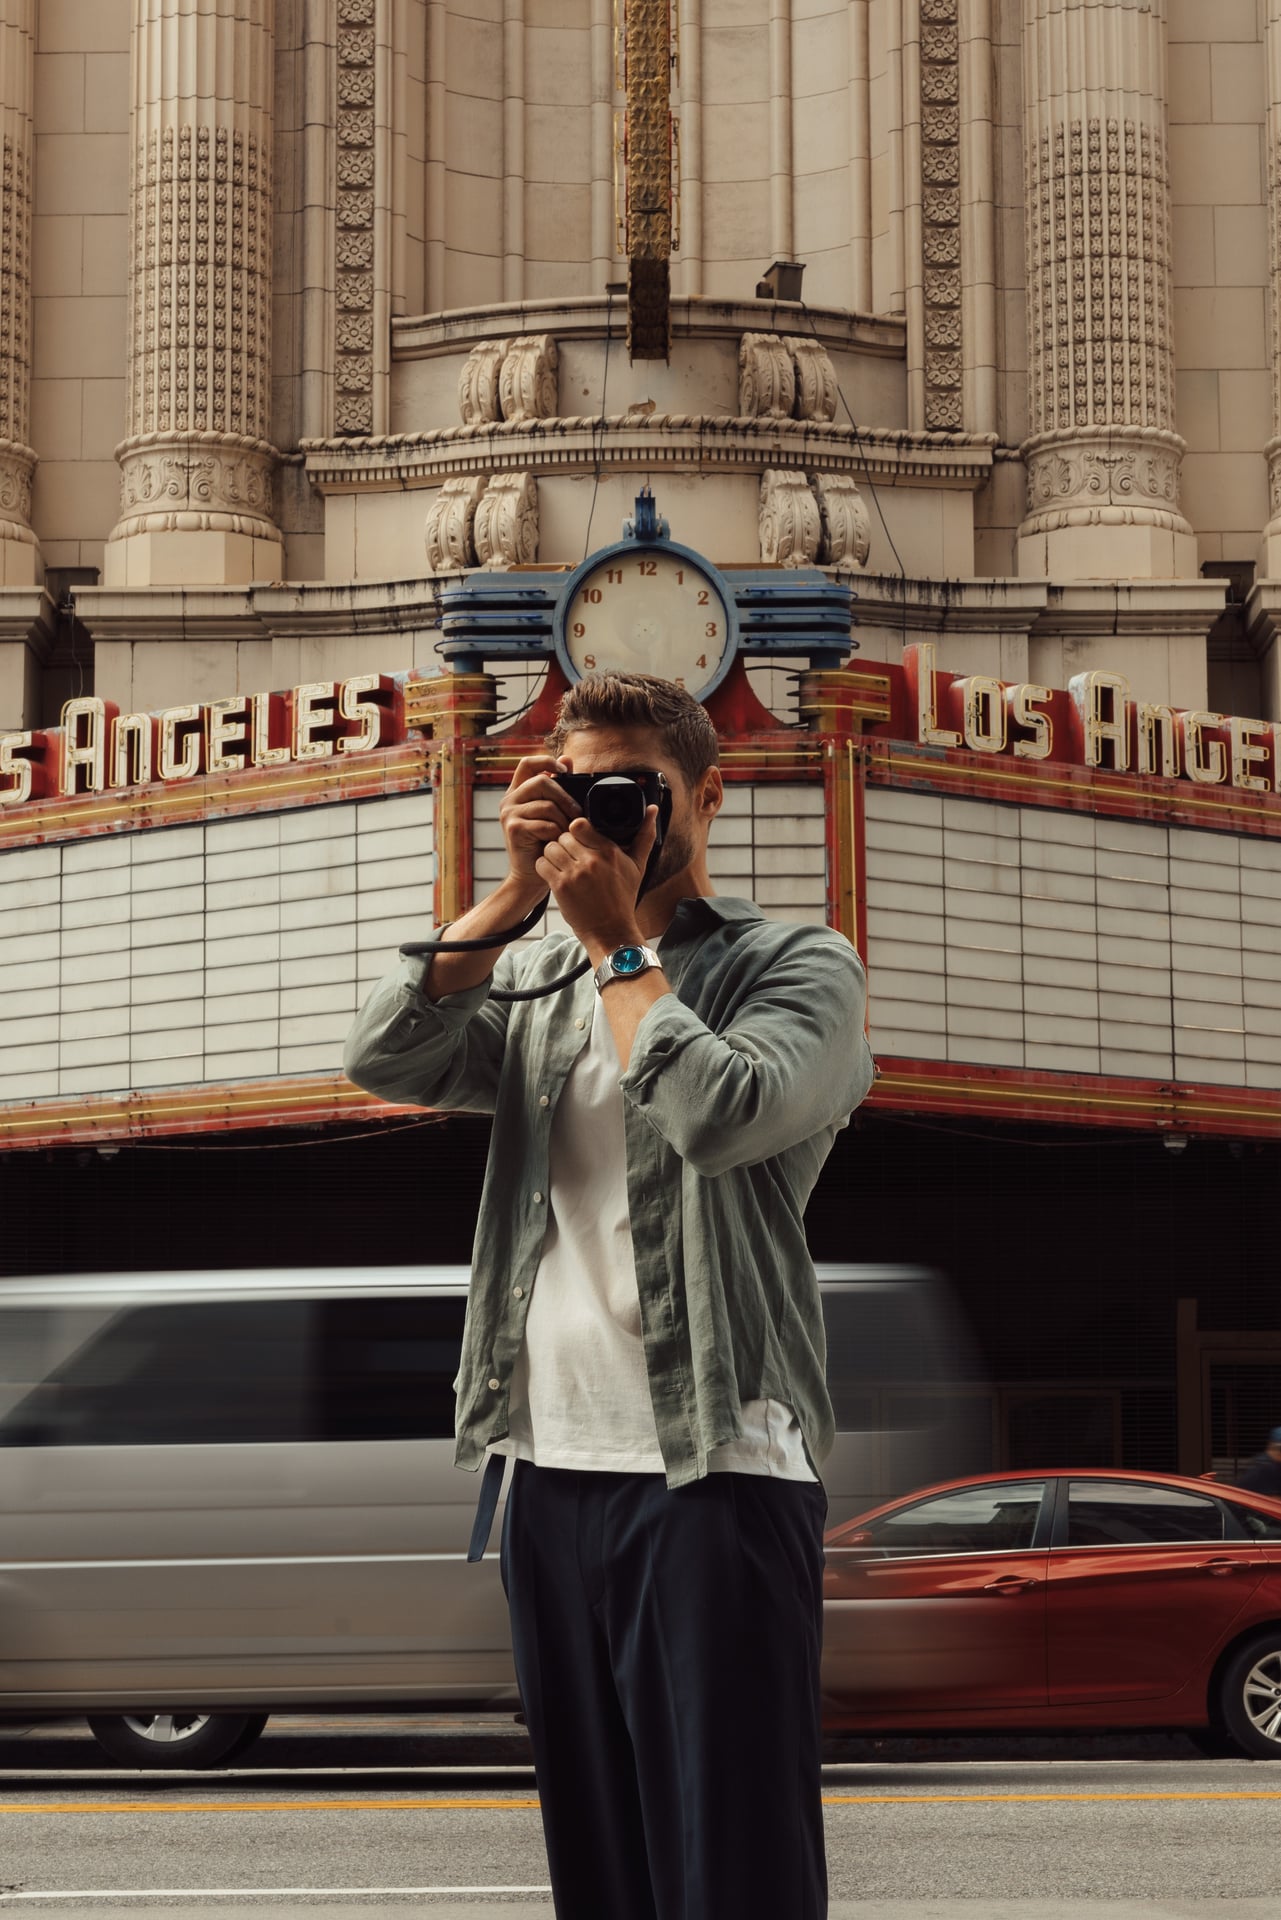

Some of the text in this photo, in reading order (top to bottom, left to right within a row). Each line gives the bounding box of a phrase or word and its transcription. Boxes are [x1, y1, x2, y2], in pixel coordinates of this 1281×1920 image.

[637, 561, 657, 576] 12
[605, 570, 623, 584] 11
[675, 570, 684, 585] 1
[581, 588, 602, 604] 10
[697, 590, 709, 605] 2
[573, 623, 585, 638] 9
[705, 622, 717, 637] 3
[584, 655, 596, 669] 8
[696, 654, 707, 669] 4
[917, 643, 1281, 794] LOS ANGE
[59, 673, 382, 797] ANGELES
